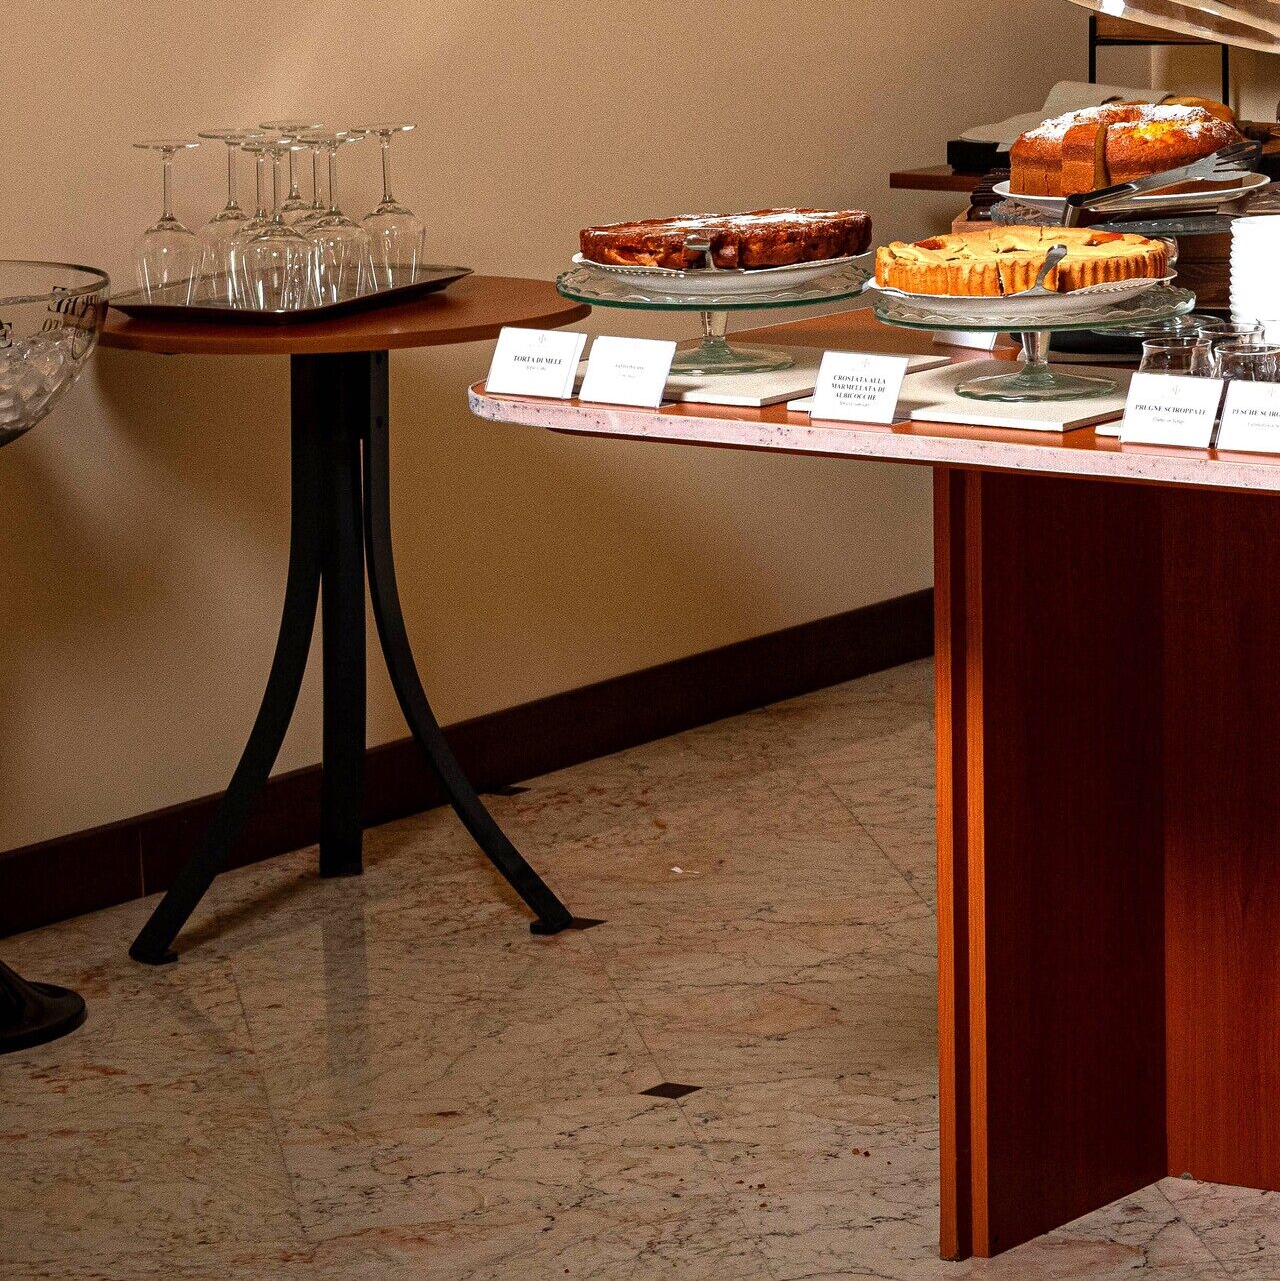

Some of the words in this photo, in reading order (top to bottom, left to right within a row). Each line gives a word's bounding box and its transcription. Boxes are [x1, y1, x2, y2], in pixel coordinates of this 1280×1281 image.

[513, 354, 536, 364] TORTA
[544, 358, 564, 366] MELE
[833, 374, 868, 384] CROSTATA
[868, 376, 887, 386] ALLA
[831, 382, 877, 393] MARMELLATA
[877, 385, 886, 394] DI
[835, 392, 878, 402] ALBICOCCHE
[1134, 403, 1163, 412] PRUGNE
[1163, 406, 1207, 416] SCIROPPATE
[1231, 407, 1259, 417] PESCHE
